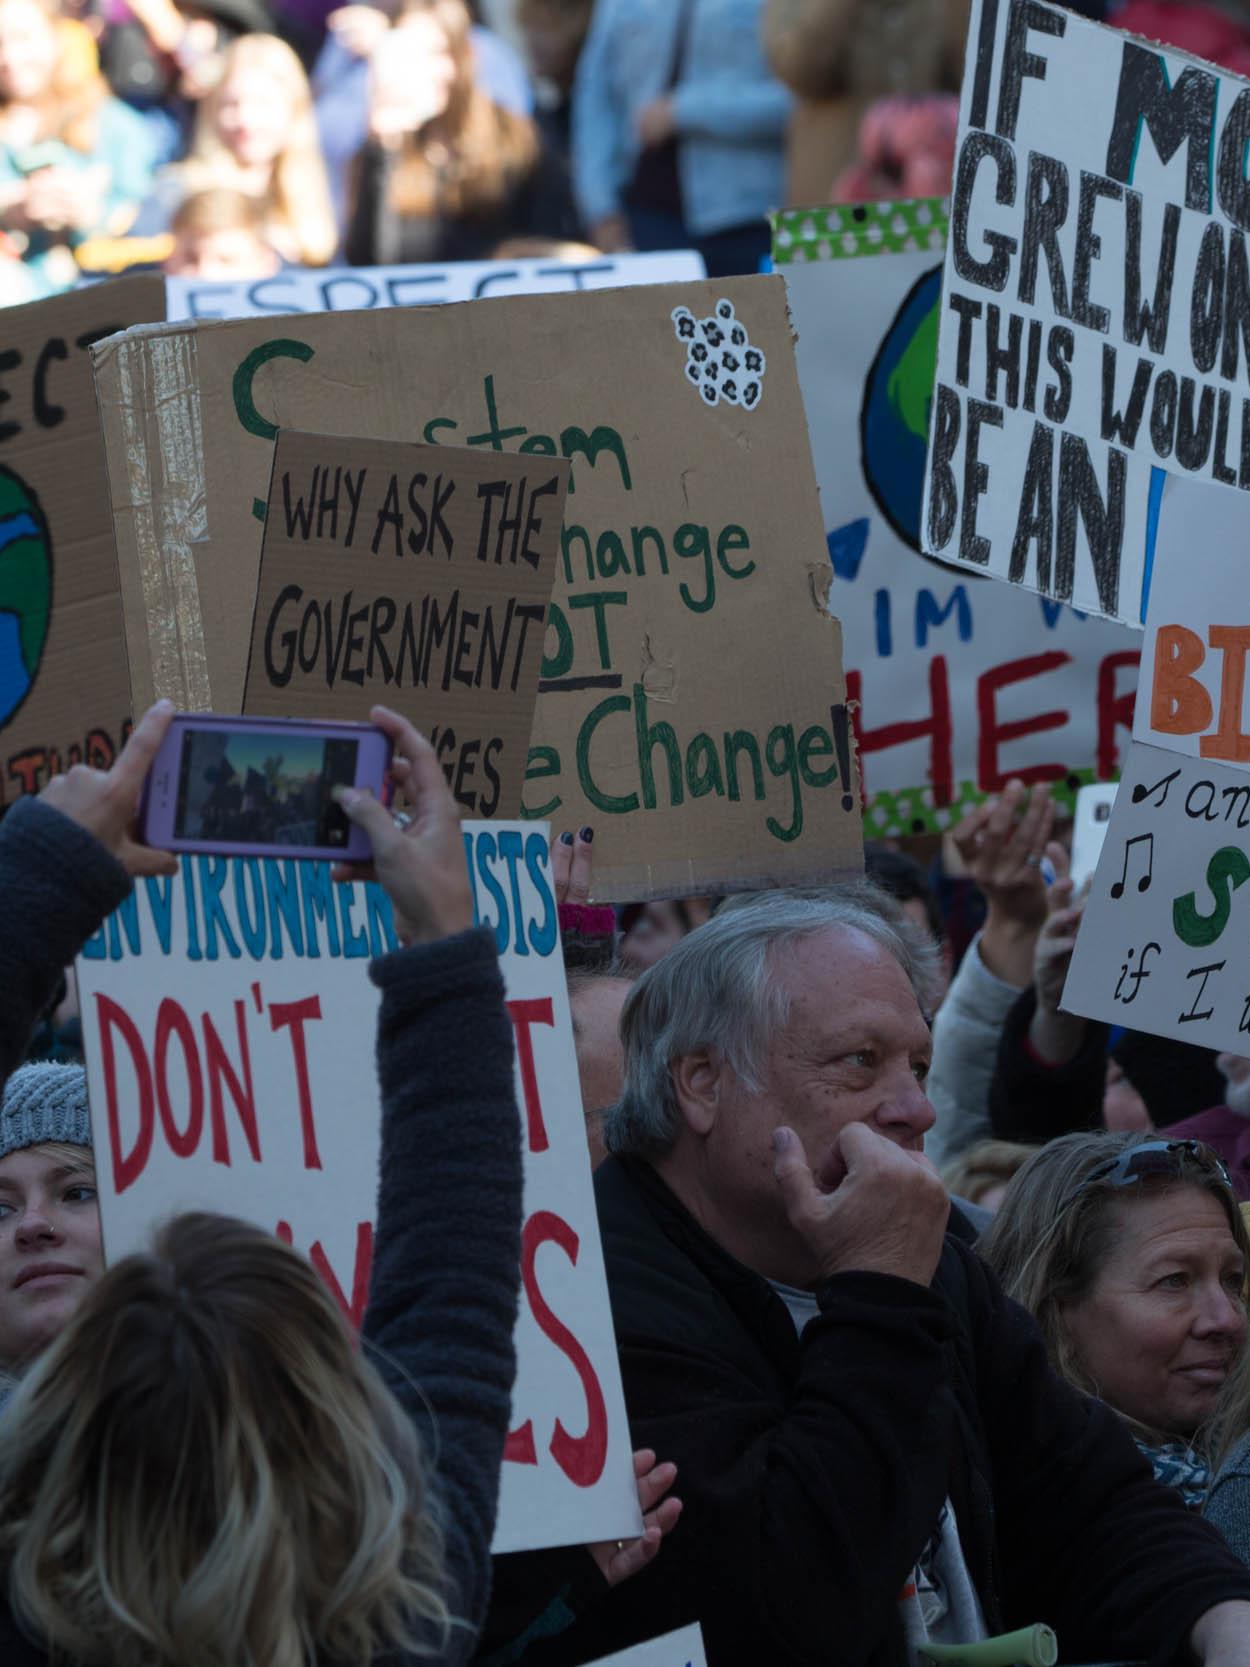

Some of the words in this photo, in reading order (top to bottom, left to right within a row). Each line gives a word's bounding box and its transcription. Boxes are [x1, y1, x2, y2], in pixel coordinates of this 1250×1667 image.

[969, 0, 1066, 142] IF
[952, 130, 1181, 355] GREW
[950, 293, 1074, 424] THIS
[282, 465, 367, 548] WHY
[371, 472, 456, 560] ASK
[476, 474, 559, 568] THE
[928, 383, 1004, 566] BE
[1008, 420, 1127, 616] AN
[264, 585, 546, 692] GOVERNMENT
[576, 683, 853, 842] Change!
[1114, 942, 1161, 1004] if
[1178, 960, 1227, 1024] I
[93, 981, 321, 1194] DON'T
